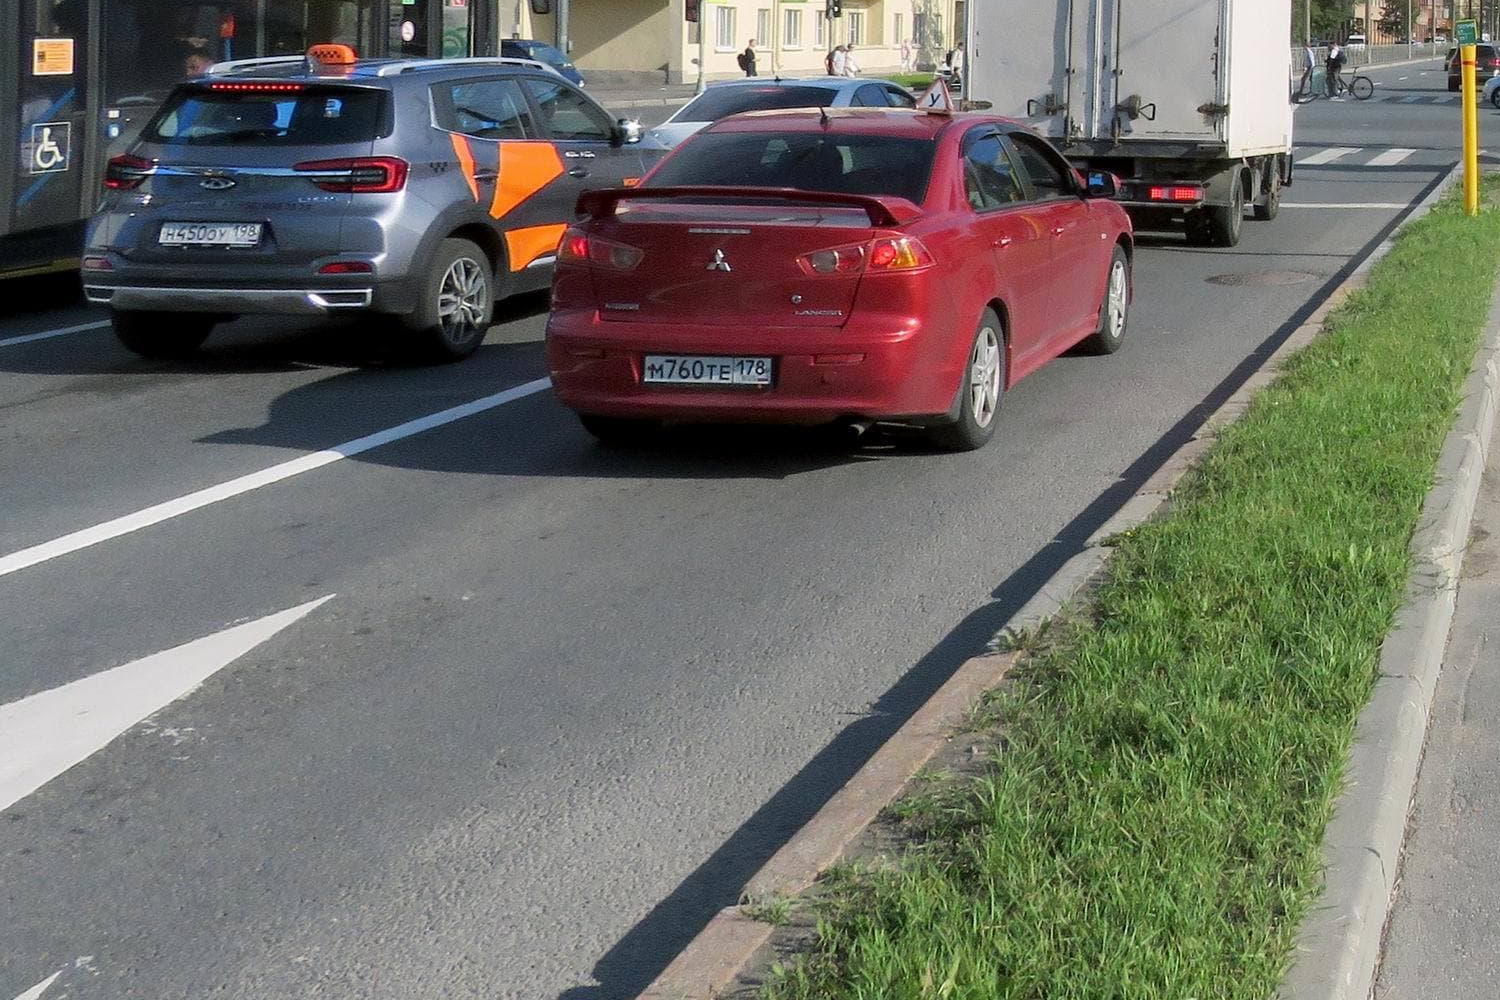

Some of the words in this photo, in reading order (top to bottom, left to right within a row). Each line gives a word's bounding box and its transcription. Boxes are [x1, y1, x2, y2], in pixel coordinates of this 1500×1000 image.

[929, 93, 942, 107] У
[233, 224, 256, 237] 198
[650, 359, 731, 380] М760ТЕ
[736, 359, 766, 376] 178
